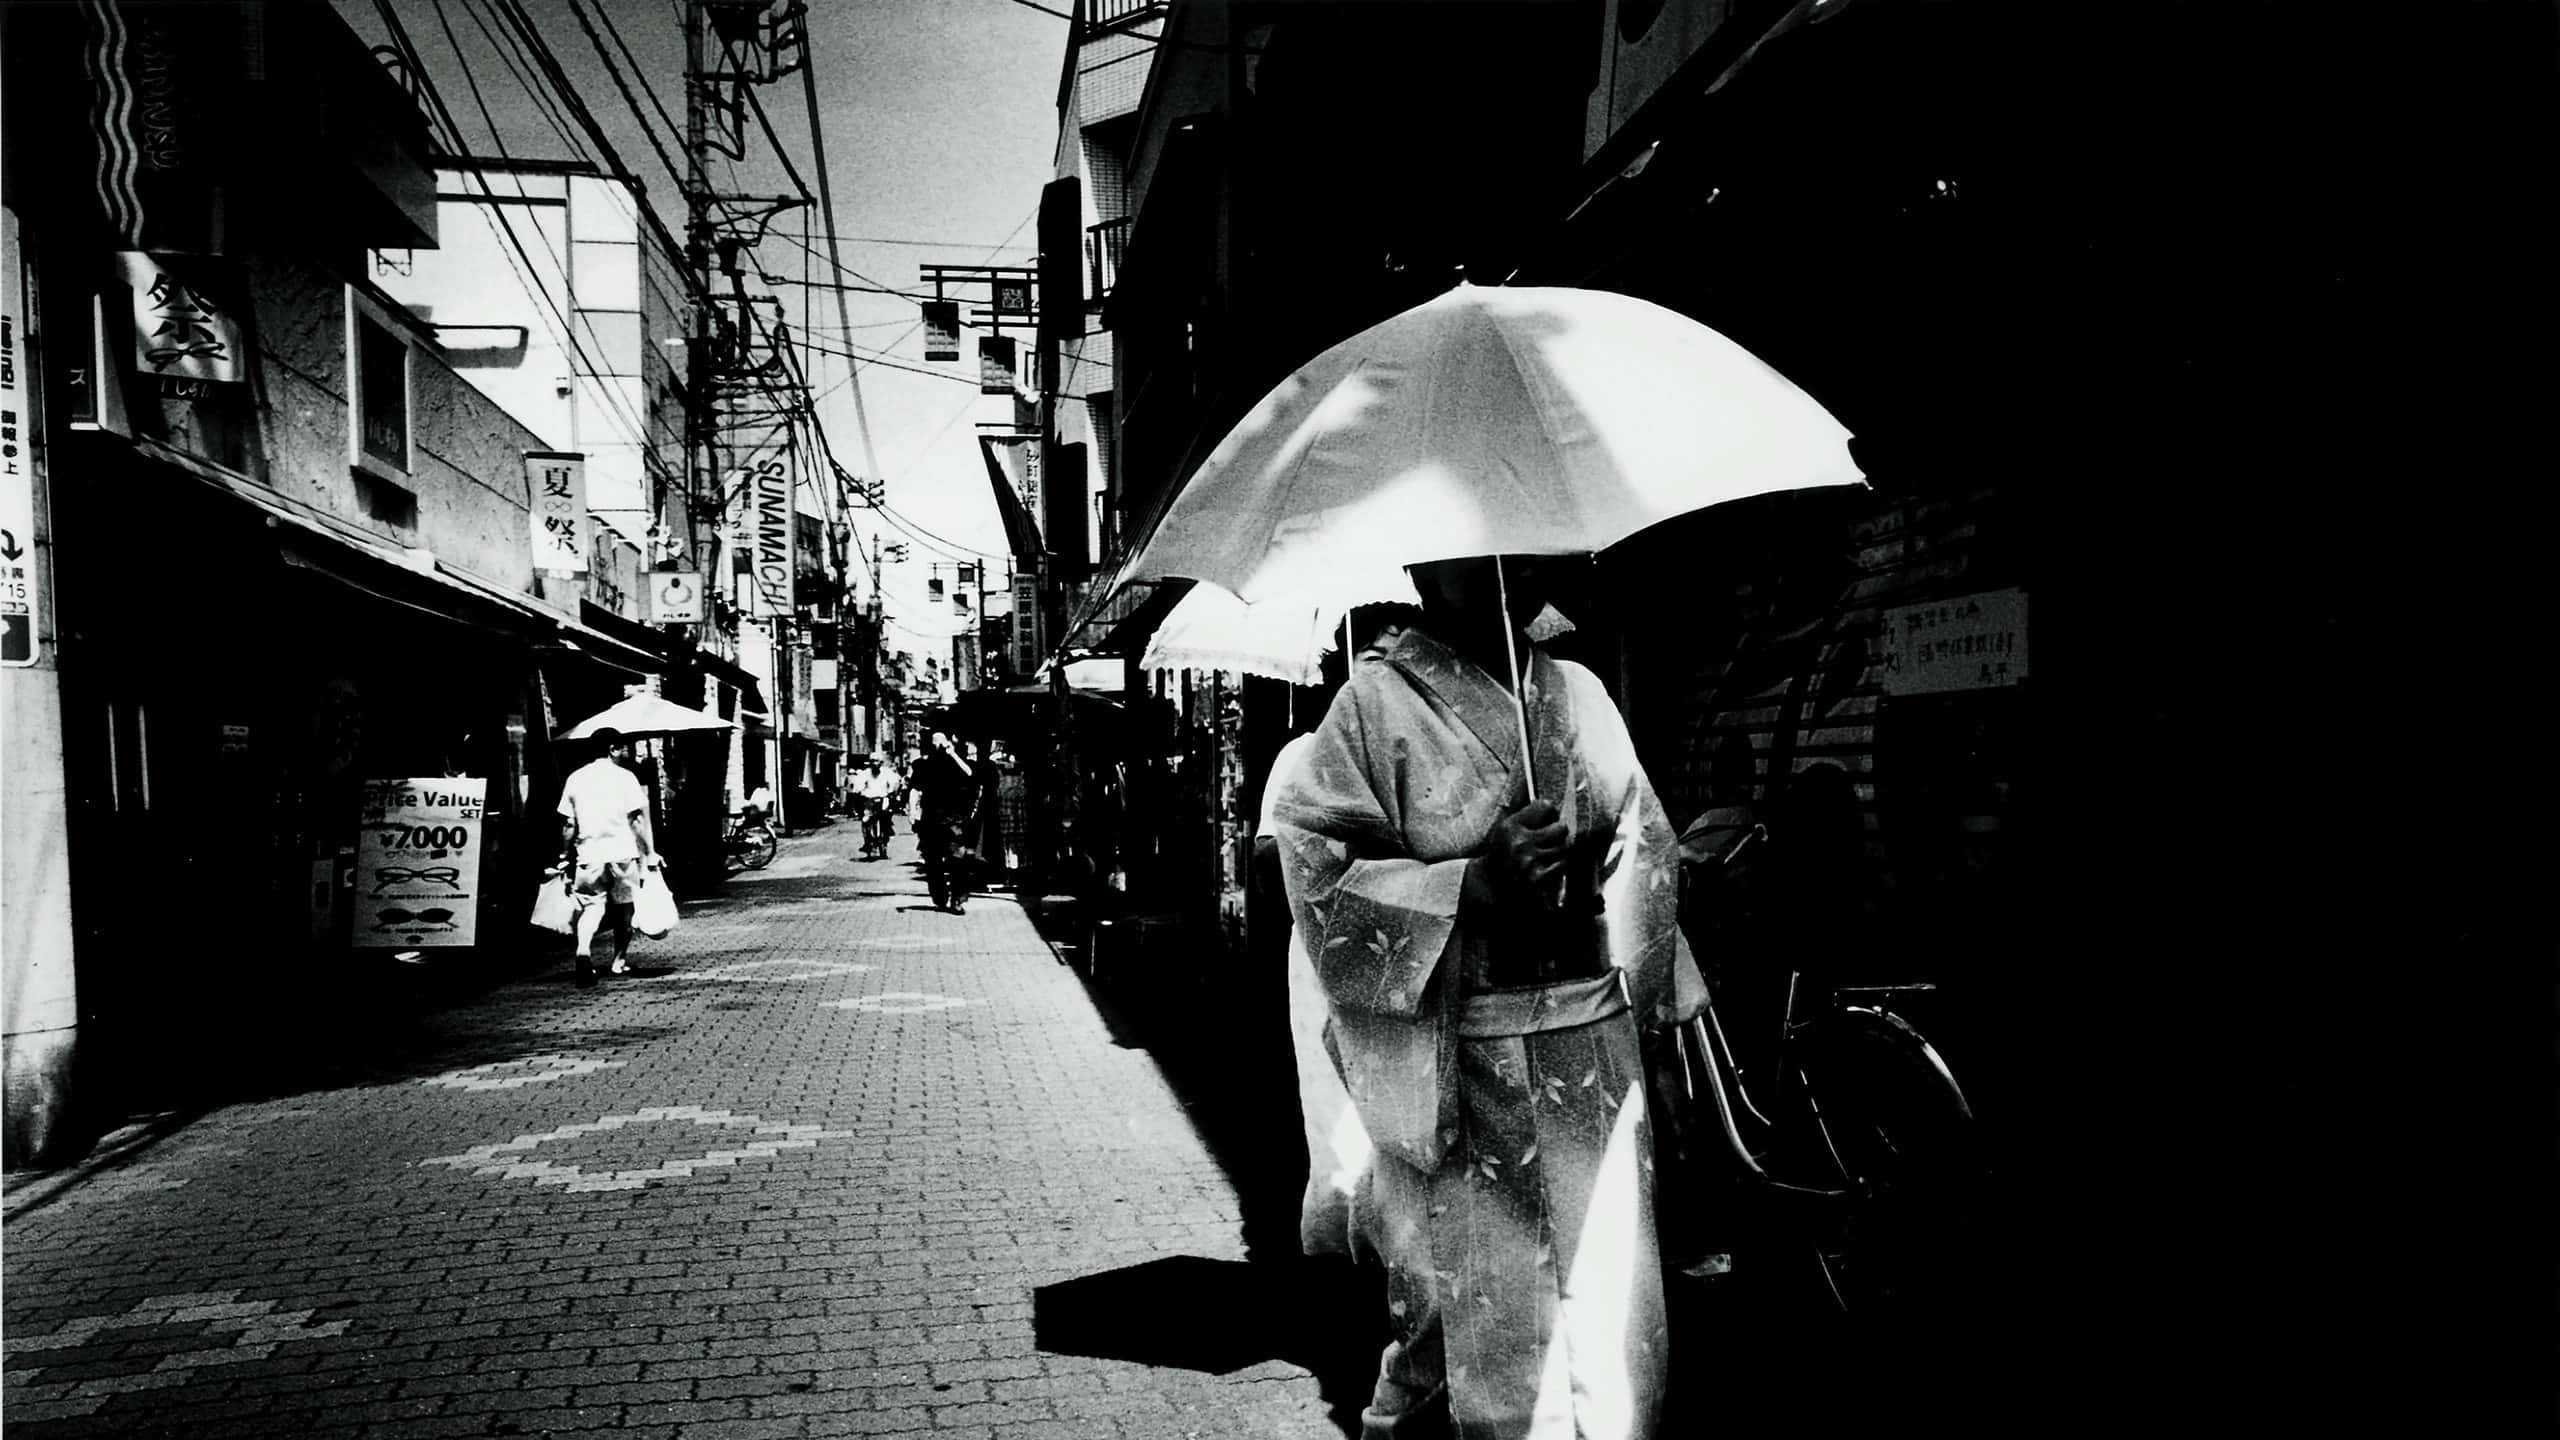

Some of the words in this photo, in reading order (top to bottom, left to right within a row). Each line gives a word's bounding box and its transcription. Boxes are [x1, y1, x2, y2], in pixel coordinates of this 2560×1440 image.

[147, 273, 217, 344] 祭
[757, 460, 787, 608] SUNAMACHI
[366, 790, 418, 808] Price
[423, 790, 483, 808] Value
[459, 808, 482, 820] SET
